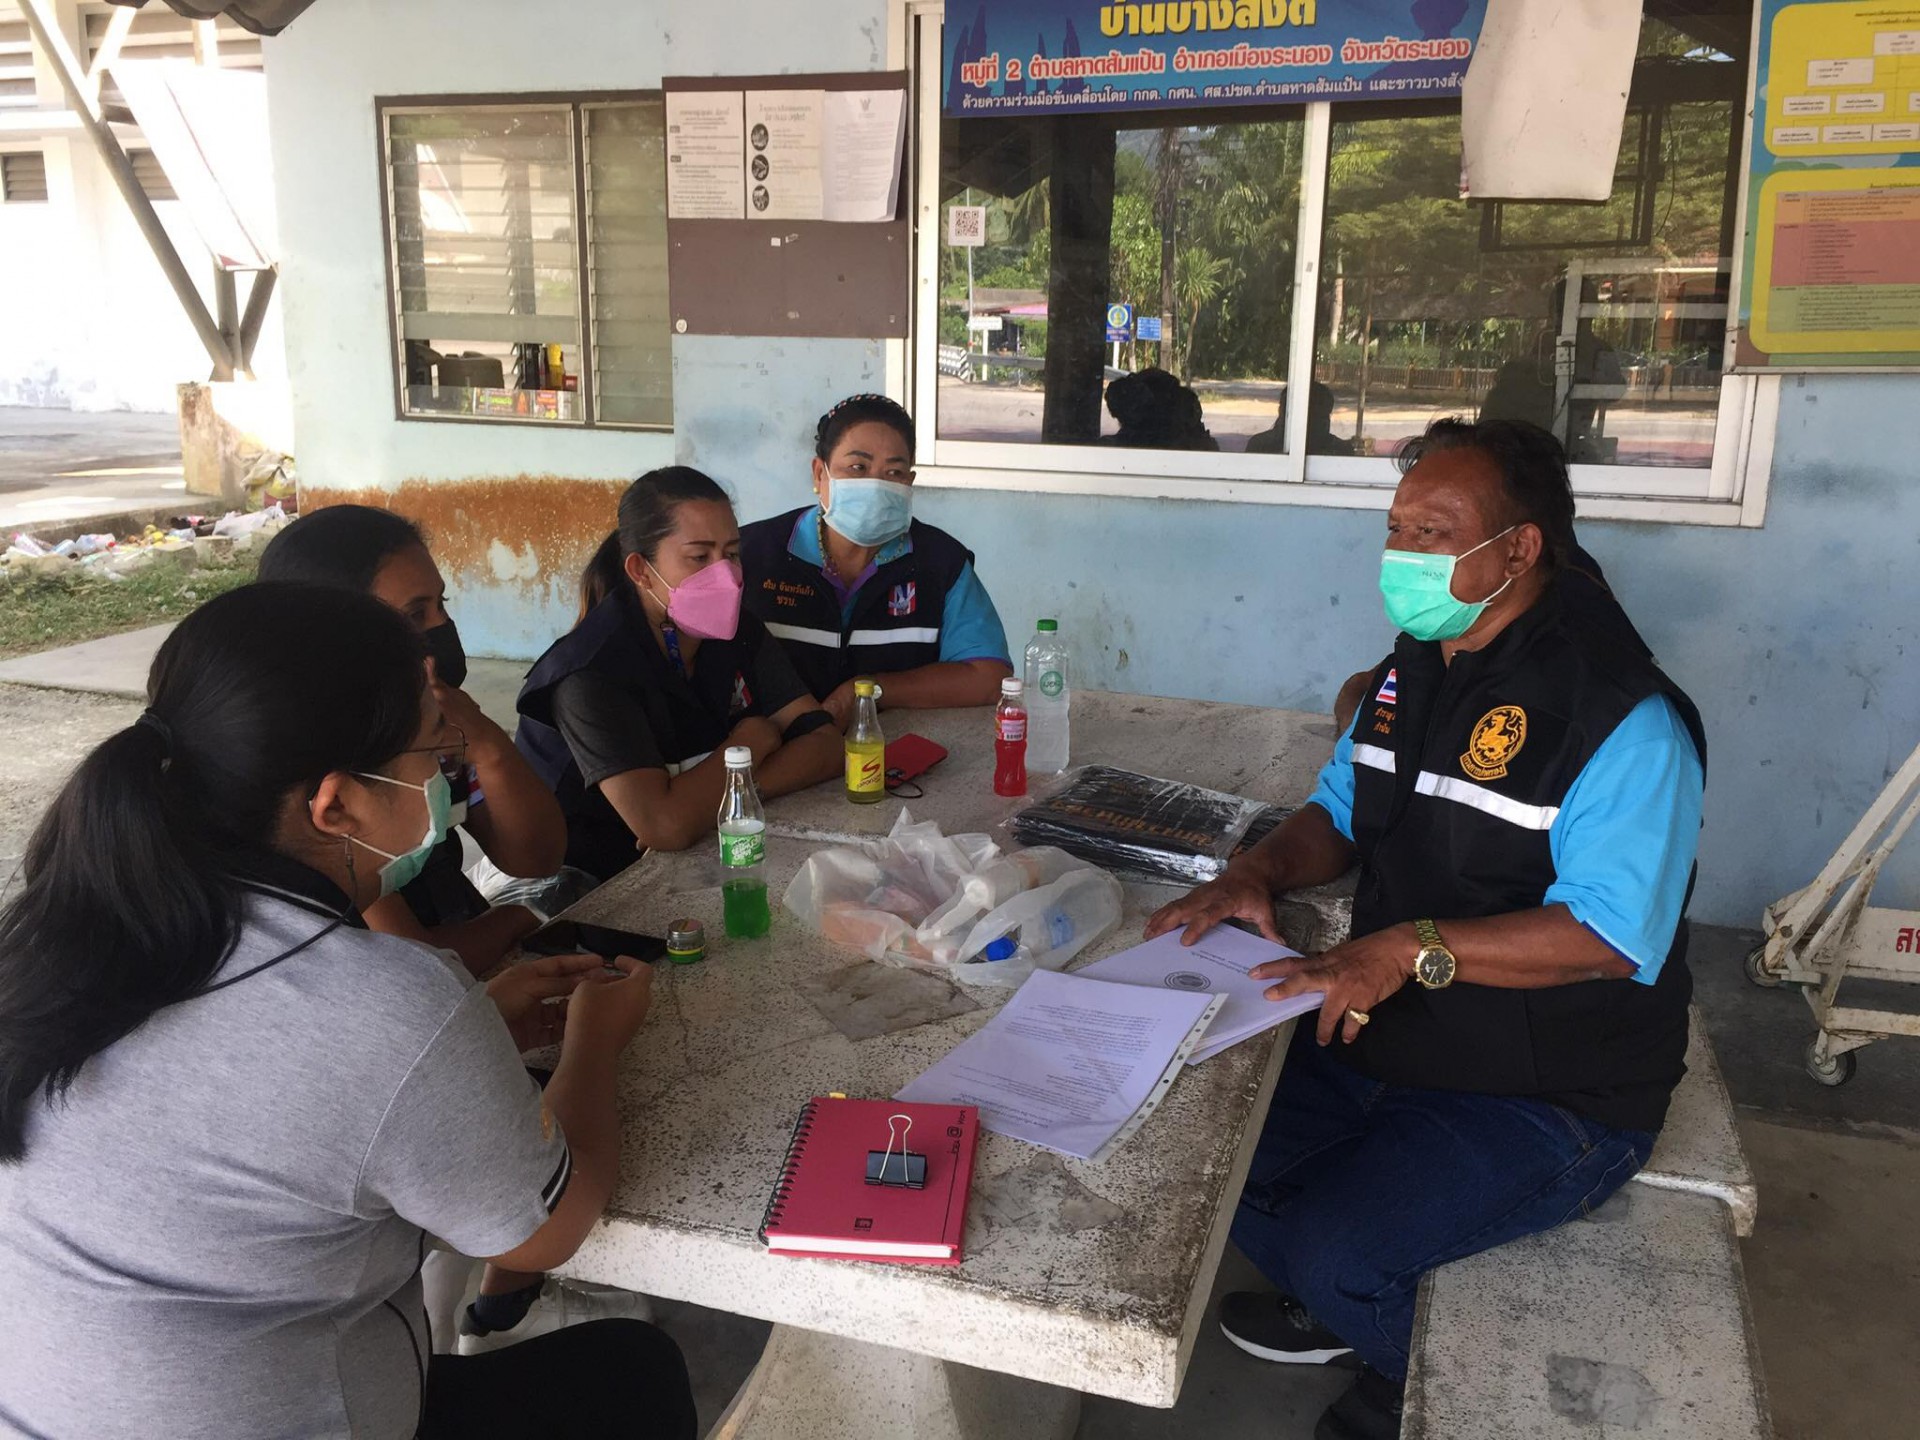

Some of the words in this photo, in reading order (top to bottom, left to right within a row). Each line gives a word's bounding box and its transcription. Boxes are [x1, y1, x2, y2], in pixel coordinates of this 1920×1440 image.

[962, 53, 999, 87] หมู่ที่
[1006, 59, 1021, 80] 2
[1030, 49, 1165, 80] ตำบลหาดส้มแป้น
[1174, 43, 1332, 72] อำเภอเมืองระนอง
[1342, 36, 1471, 64] จังหวัดระนอง
[963, 85, 1127, 109] ด้วยความร่วมมือขับเคลื่อนโดย
[1133, 90, 1161, 102] กกต.
